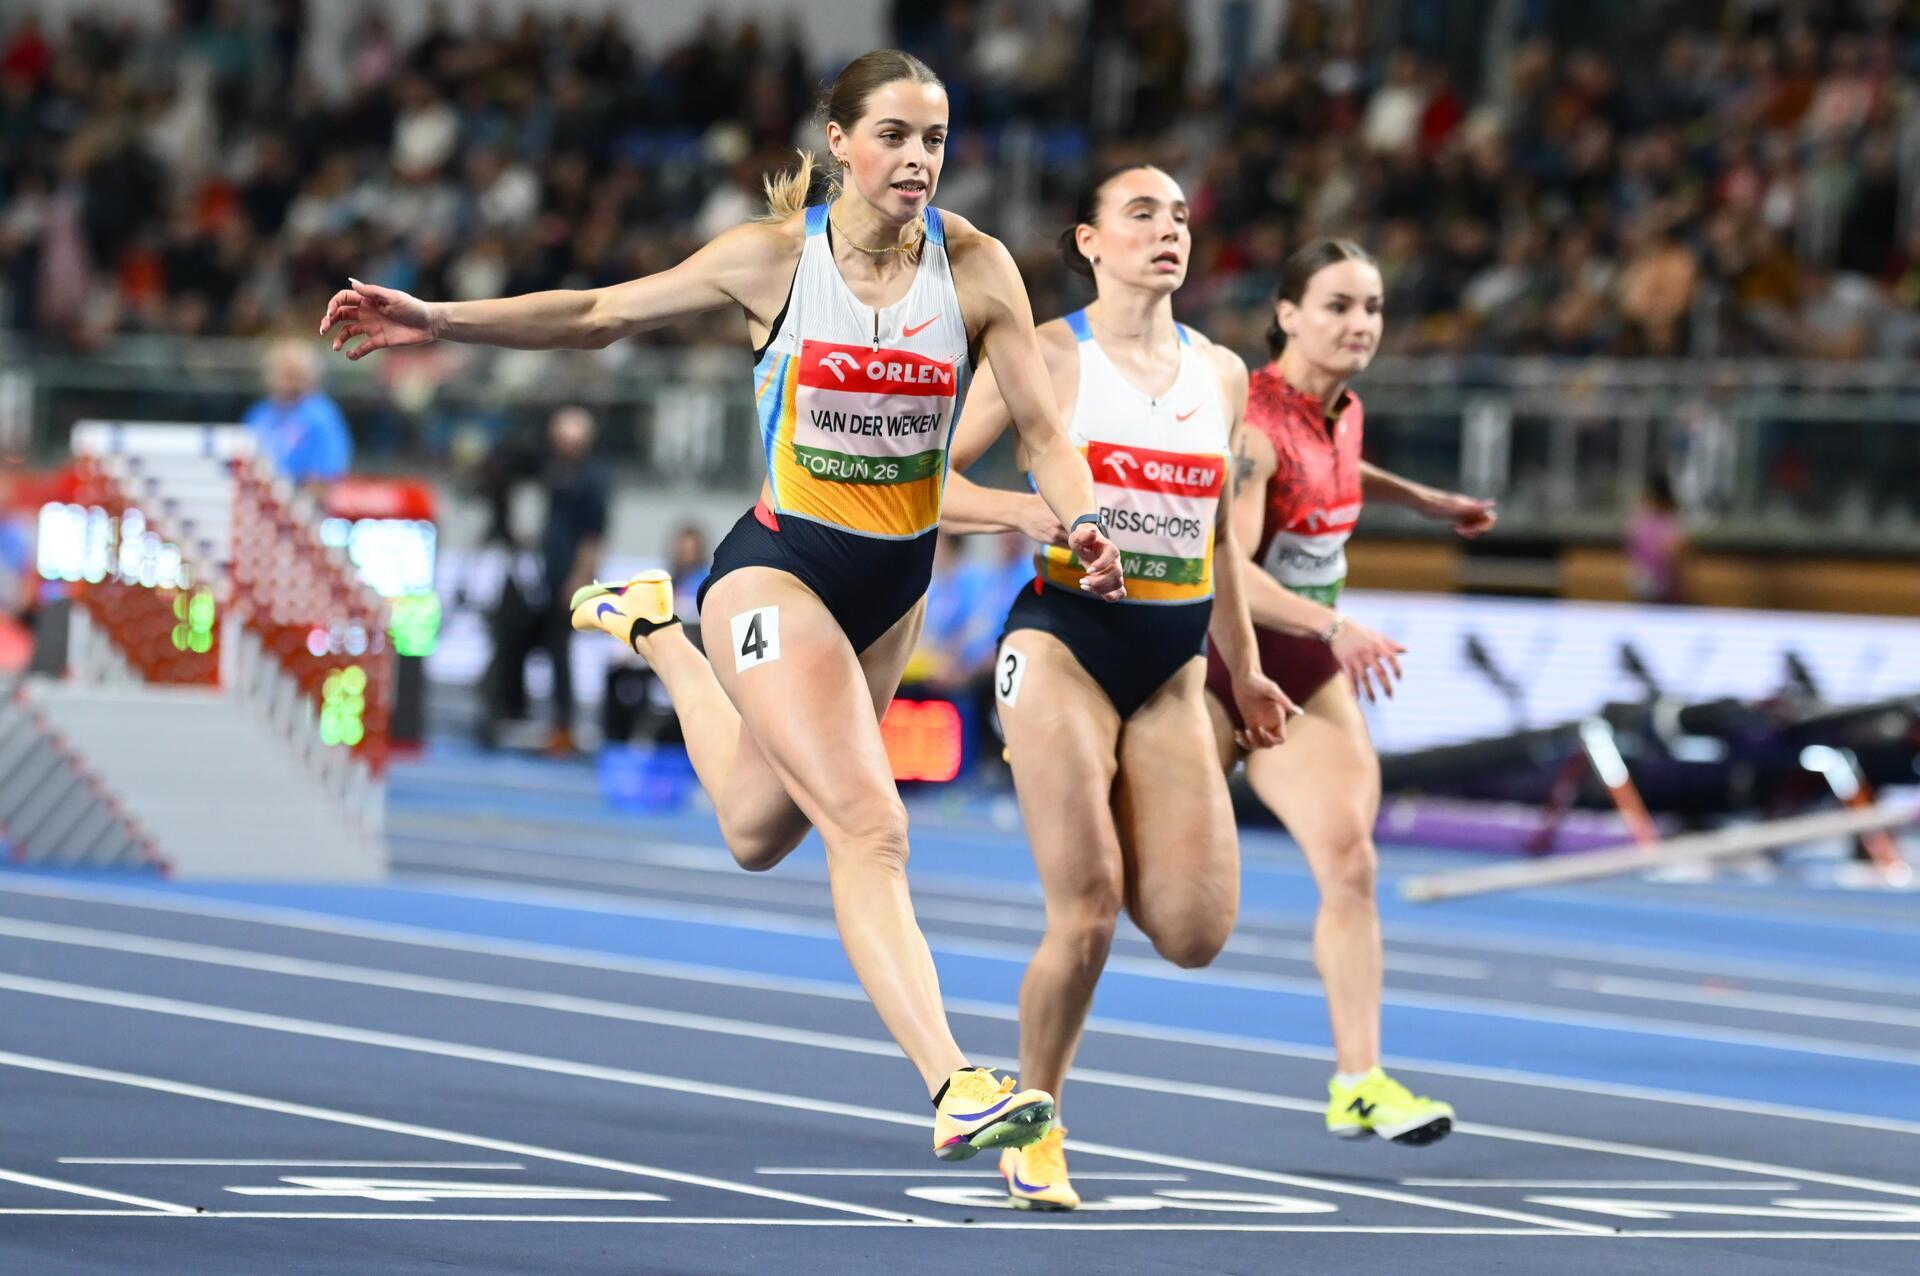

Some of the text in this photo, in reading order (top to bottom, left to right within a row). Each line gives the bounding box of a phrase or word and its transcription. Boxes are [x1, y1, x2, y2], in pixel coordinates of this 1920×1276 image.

[867, 361, 951, 385] ORLEN
[811, 410, 942, 437] VAN DER WEKEN
[800, 452, 899, 480] TORUŃ 26
[1143, 461, 1216, 487] ORLEN
[1100, 506, 1200, 539] BISSCHOPS
[1144, 560, 1167, 578] 26
[741, 612, 768, 660] 4
[1000, 654, 1017, 698] 3
